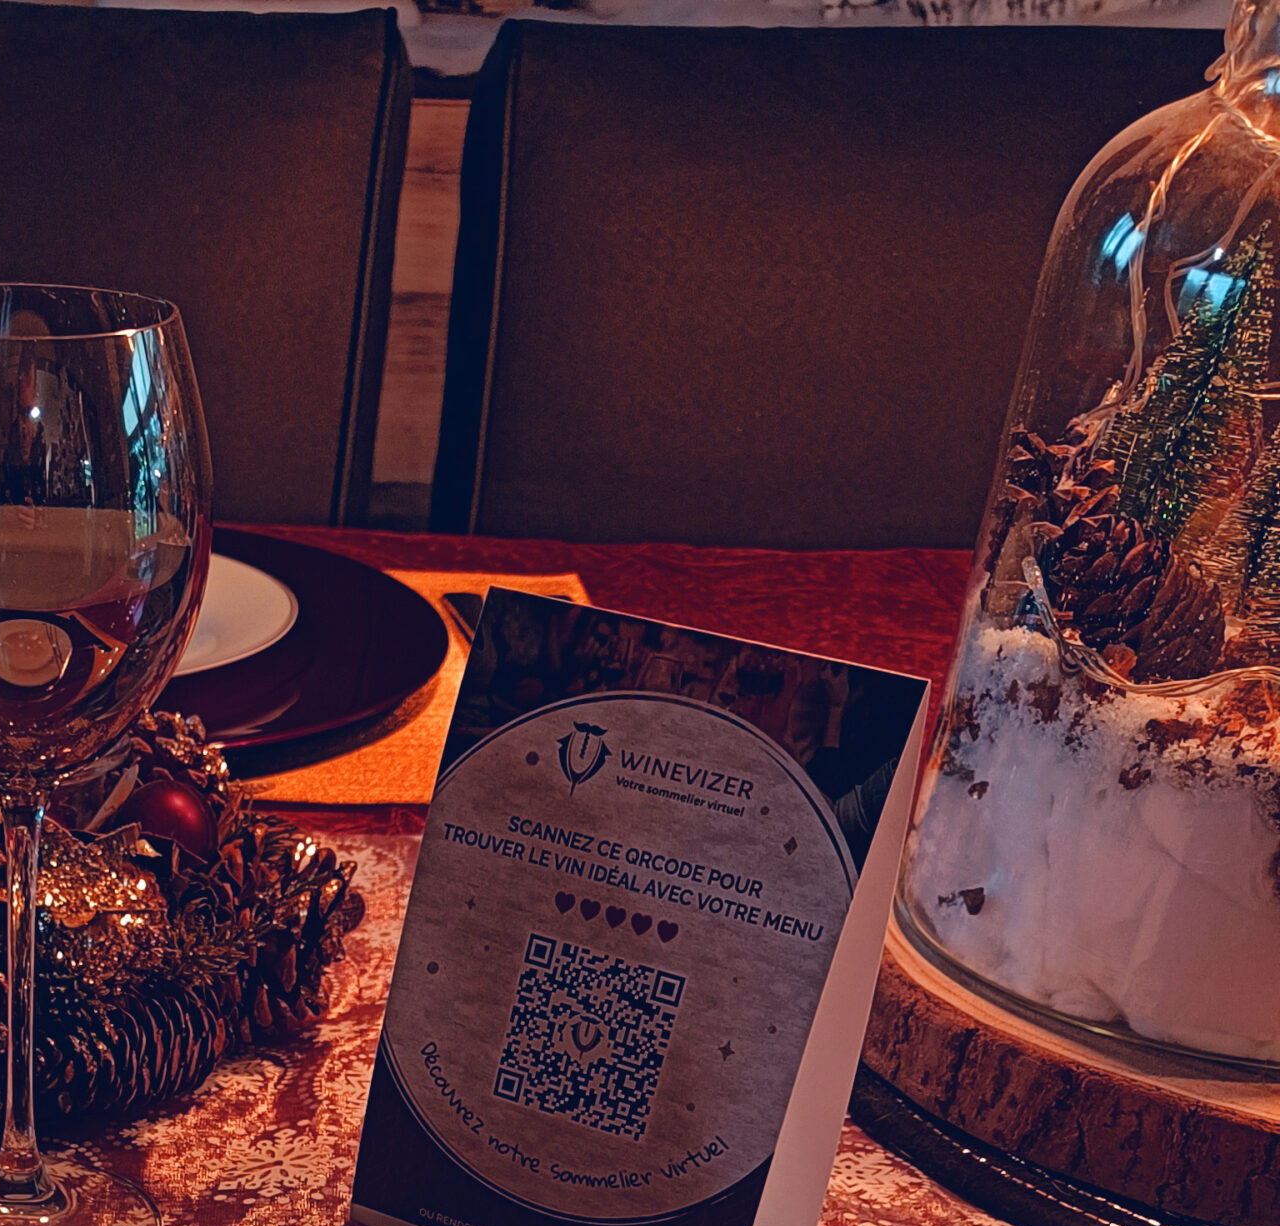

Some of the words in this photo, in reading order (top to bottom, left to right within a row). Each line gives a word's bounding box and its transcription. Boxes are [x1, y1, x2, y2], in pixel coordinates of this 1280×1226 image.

[616, 775, 645, 792] Votre
[646, 785, 706, 807] sommelier
[707, 800, 745, 817] virtuel
[621, 750, 754, 800] WINEVIZER
[443, 822, 525, 860] TROUVER
[528, 847, 552, 867] LE
[554, 853, 586, 877] VIN
[587, 863, 640, 892] IDÉAL
[643, 879, 694, 906] AVEC
[697, 892, 761, 925] VOTRE
[762, 911, 824, 941] MENU
[507, 815, 595, 853] SCANNEZ
[597, 840, 622, 861] CE
[625, 847, 706, 883] QRCODE
[707, 869, 763, 899] POUR
[421, 1041, 484, 1135] Découvrez
[488, 1135, 540, 1173] notre
[550, 1163, 652, 1189] sommelier
[659, 1135, 730, 1180] virtuel
[419, 1208, 435, 1219] OU
